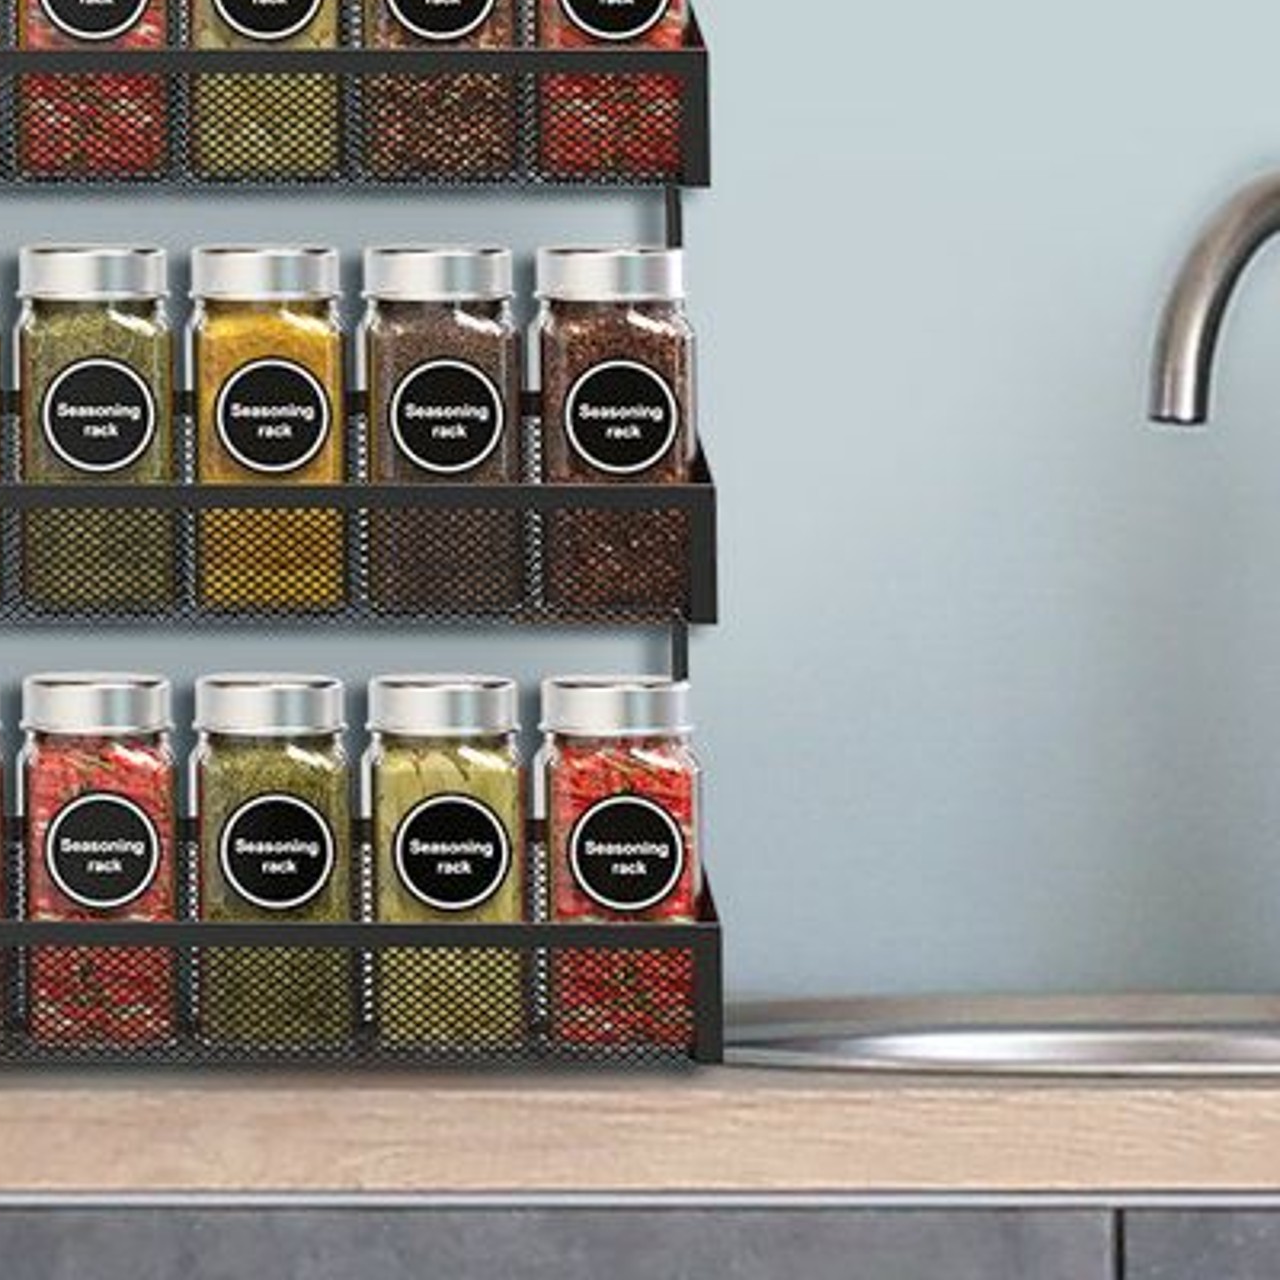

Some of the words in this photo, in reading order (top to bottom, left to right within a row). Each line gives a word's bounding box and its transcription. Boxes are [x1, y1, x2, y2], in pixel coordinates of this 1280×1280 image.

[57, 402, 142, 421] Seasoning
[230, 402, 315, 421] Seasoning
[405, 403, 489, 421] Seasoning
[578, 403, 664, 422] Seasoning
[83, 422, 119, 437] rack
[257, 423, 292, 438] rack
[431, 423, 467, 439] rack
[606, 425, 641, 439] rack
[60, 837, 145, 856] Seasoning
[235, 838, 320, 857] Seasoning
[409, 838, 494, 858] Seasoning
[584, 840, 670, 859] Seasoning
[87, 859, 122, 873] rack
[261, 859, 296, 874] rack
[437, 860, 472, 874] rack
[611, 860, 647, 875] rack
